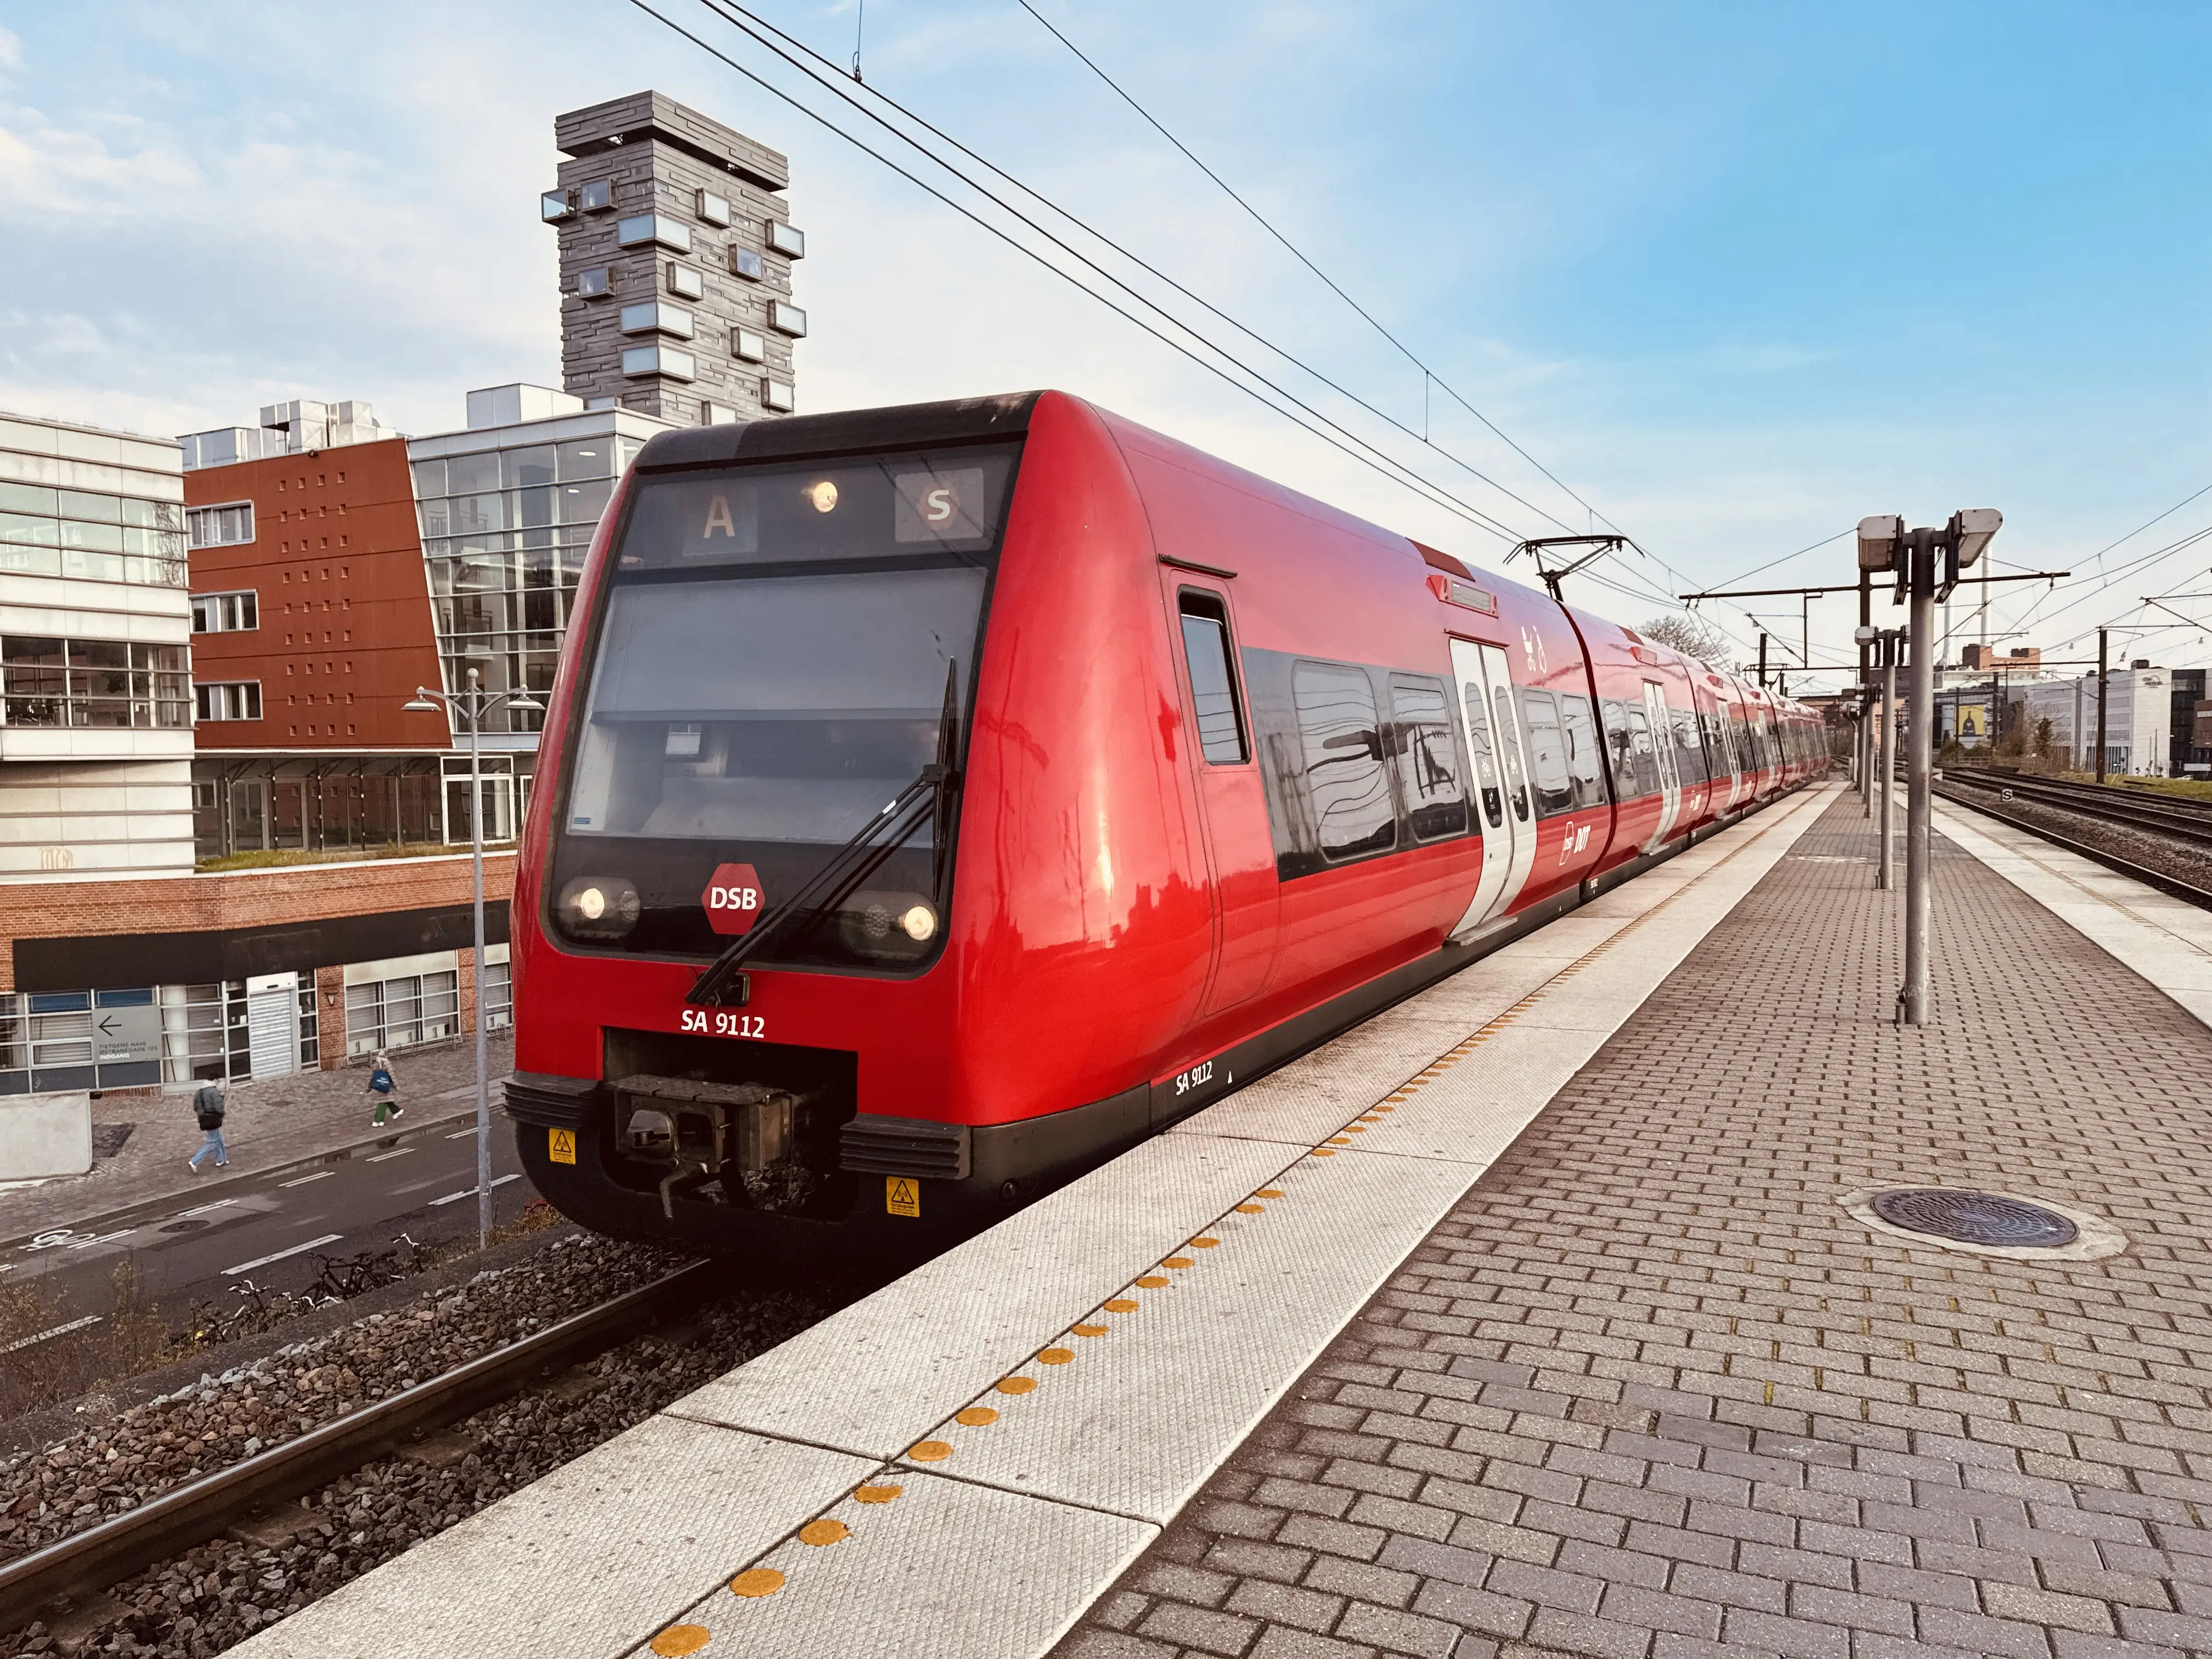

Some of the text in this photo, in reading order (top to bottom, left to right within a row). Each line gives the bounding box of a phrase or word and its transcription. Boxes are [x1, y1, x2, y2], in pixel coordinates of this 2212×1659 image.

[703, 495, 735, 538] A
[927, 489, 951, 520] S
[2003, 791, 2012, 800] S
[710, 887, 757, 910] DSB
[681, 1009, 765, 1039] SA 9112
[1176, 1060, 1212, 1096] SA 9112
